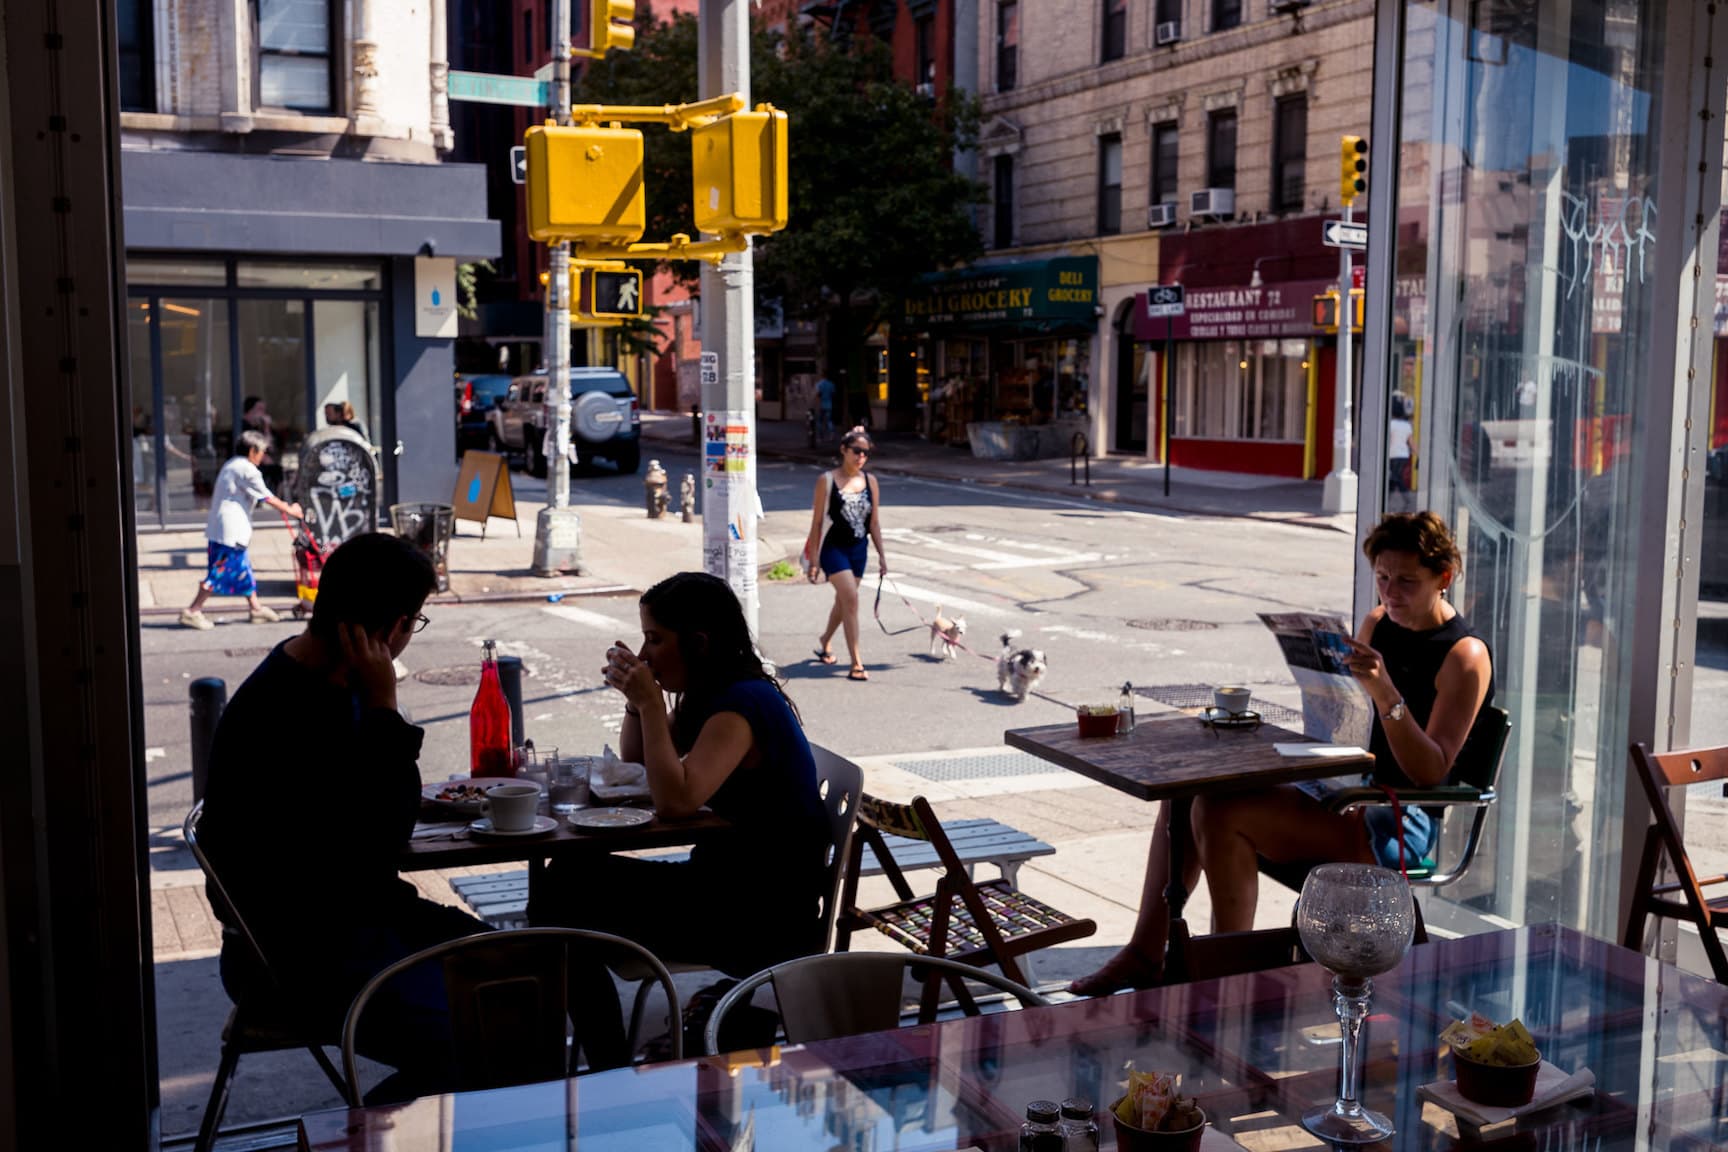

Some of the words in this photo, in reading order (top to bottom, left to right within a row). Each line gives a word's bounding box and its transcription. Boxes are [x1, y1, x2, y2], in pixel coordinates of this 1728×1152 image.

[1059, 271, 1083, 285] DELI
[904, 296, 944, 317] DELI
[946, 287, 1032, 313] GROCERY
[1048, 288, 1093, 303] GROCERY
[1185, 289, 1262, 309] RESTAURANT
